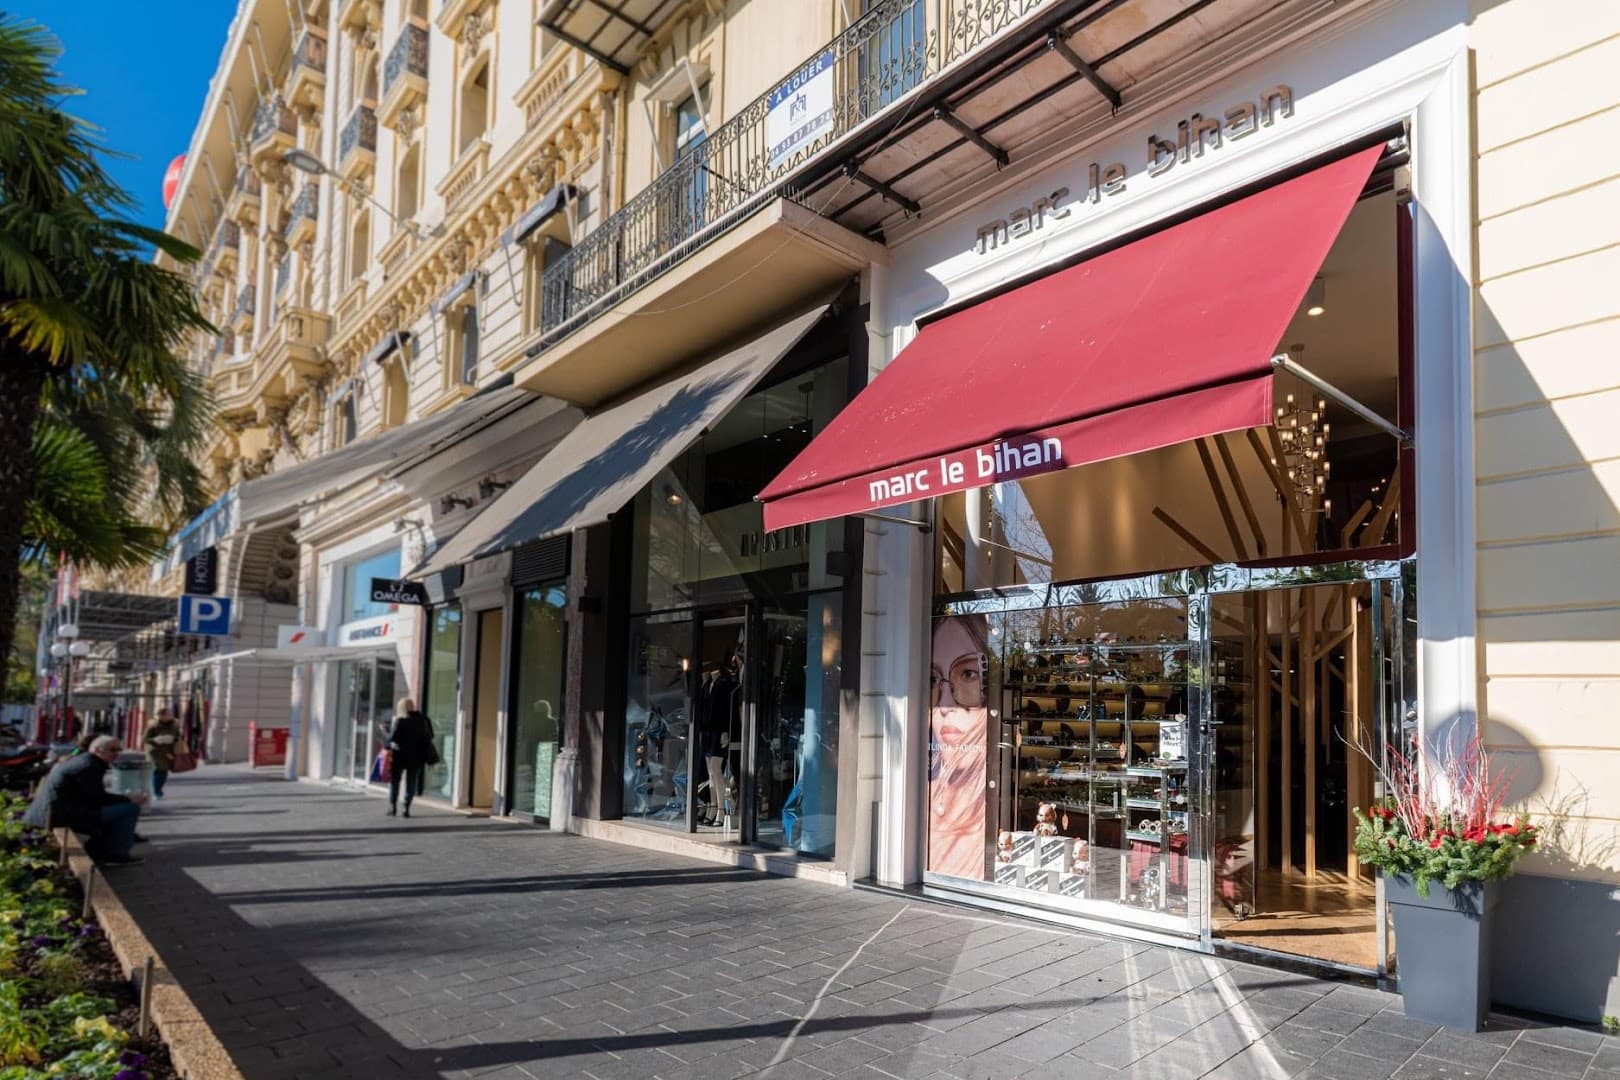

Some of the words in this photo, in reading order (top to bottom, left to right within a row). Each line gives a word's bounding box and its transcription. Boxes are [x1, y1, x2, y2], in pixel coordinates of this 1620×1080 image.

[787, 60, 822, 94] LOUER
[975, 187, 1070, 254] marc
[1088, 163, 1126, 204] le
[1148, 84, 1294, 177] bihan
[869, 470, 929, 502] marc
[940, 458, 964, 486] le
[976, 437, 1062, 478] bihan
[374, 591, 419, 603] OMEGA
[190, 598, 222, 632] P
